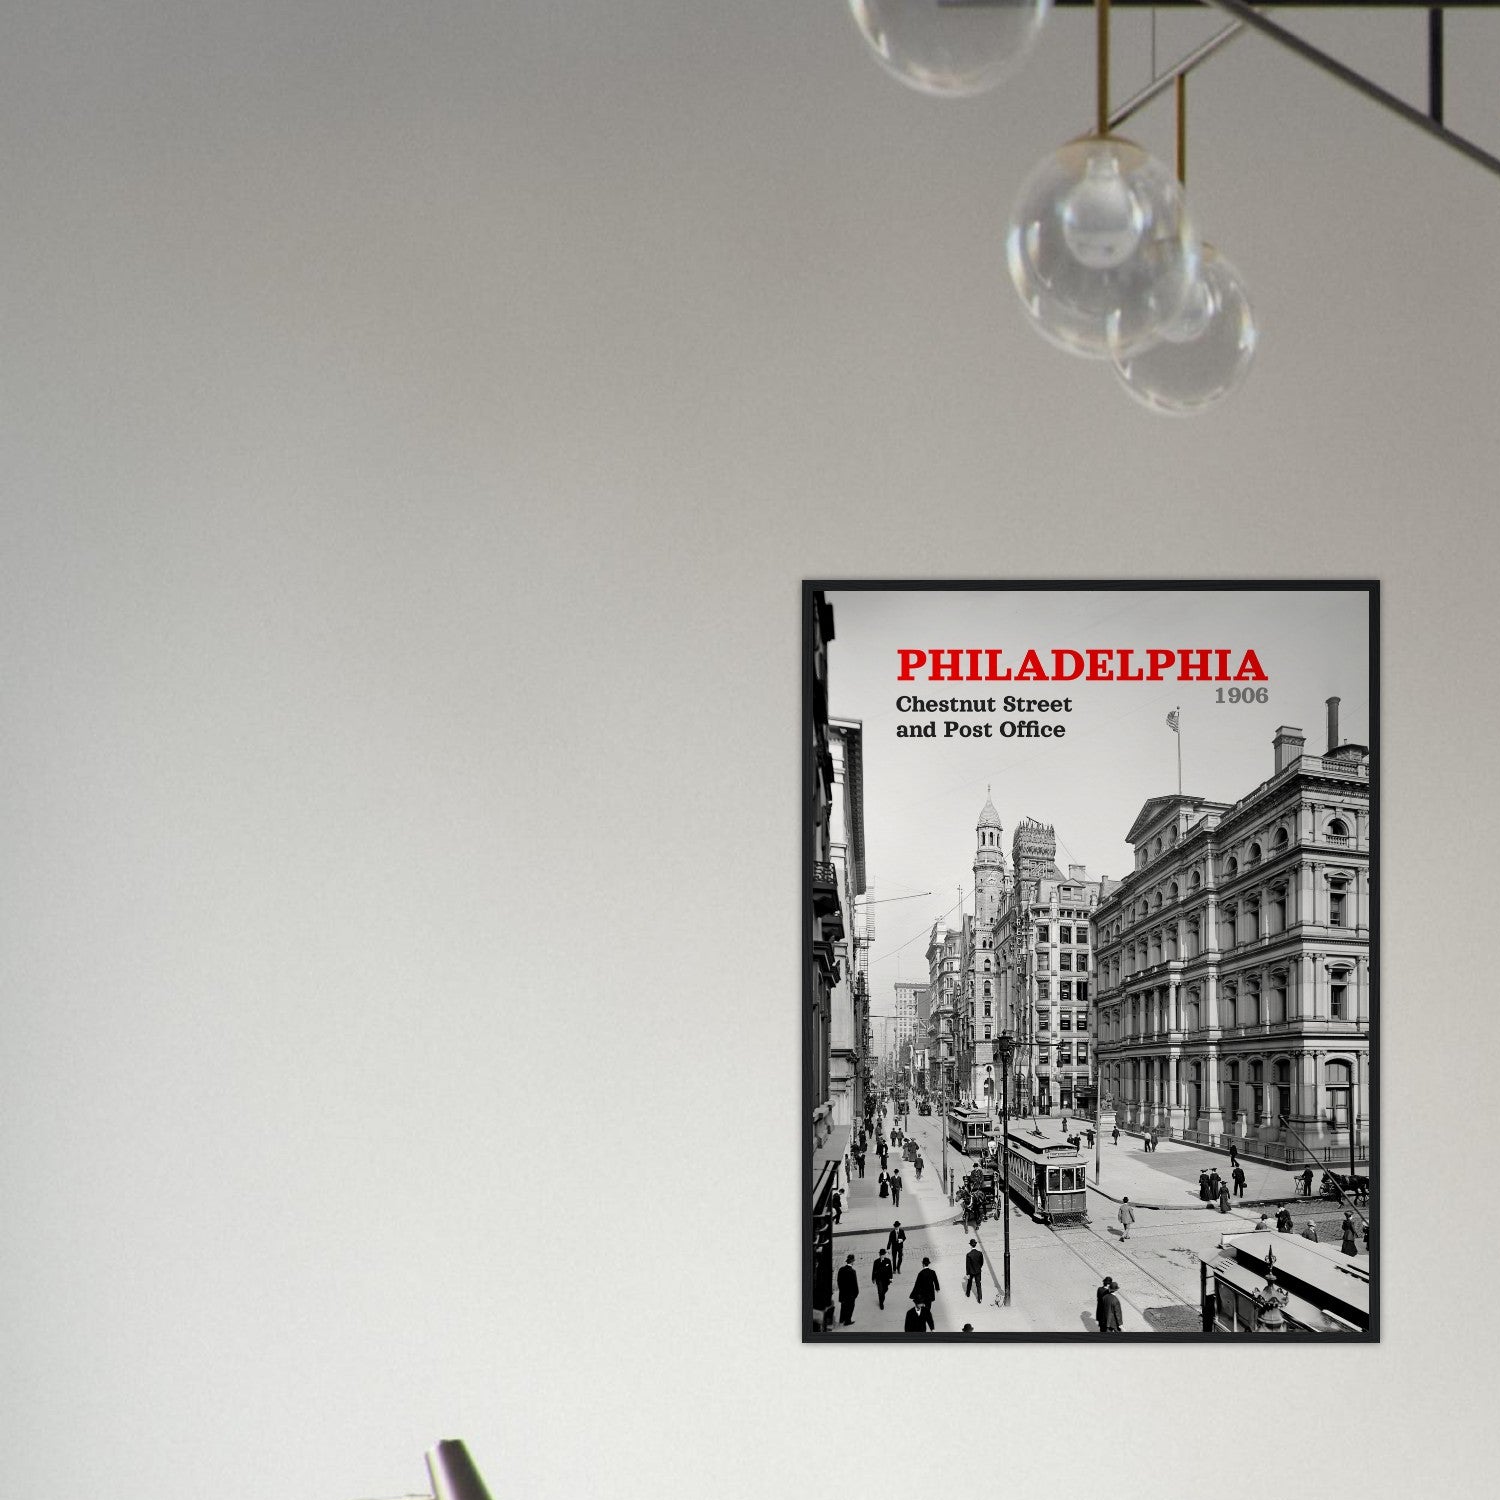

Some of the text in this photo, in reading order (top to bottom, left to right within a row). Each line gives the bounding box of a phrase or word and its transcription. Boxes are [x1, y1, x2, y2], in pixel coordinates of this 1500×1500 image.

[896, 649, 1270, 681] PHILADELPHIA
[896, 695, 1072, 712] Chestnut Street
[1215, 687, 1269, 704] 1906
[896, 720, 1066, 737] and Post Office
